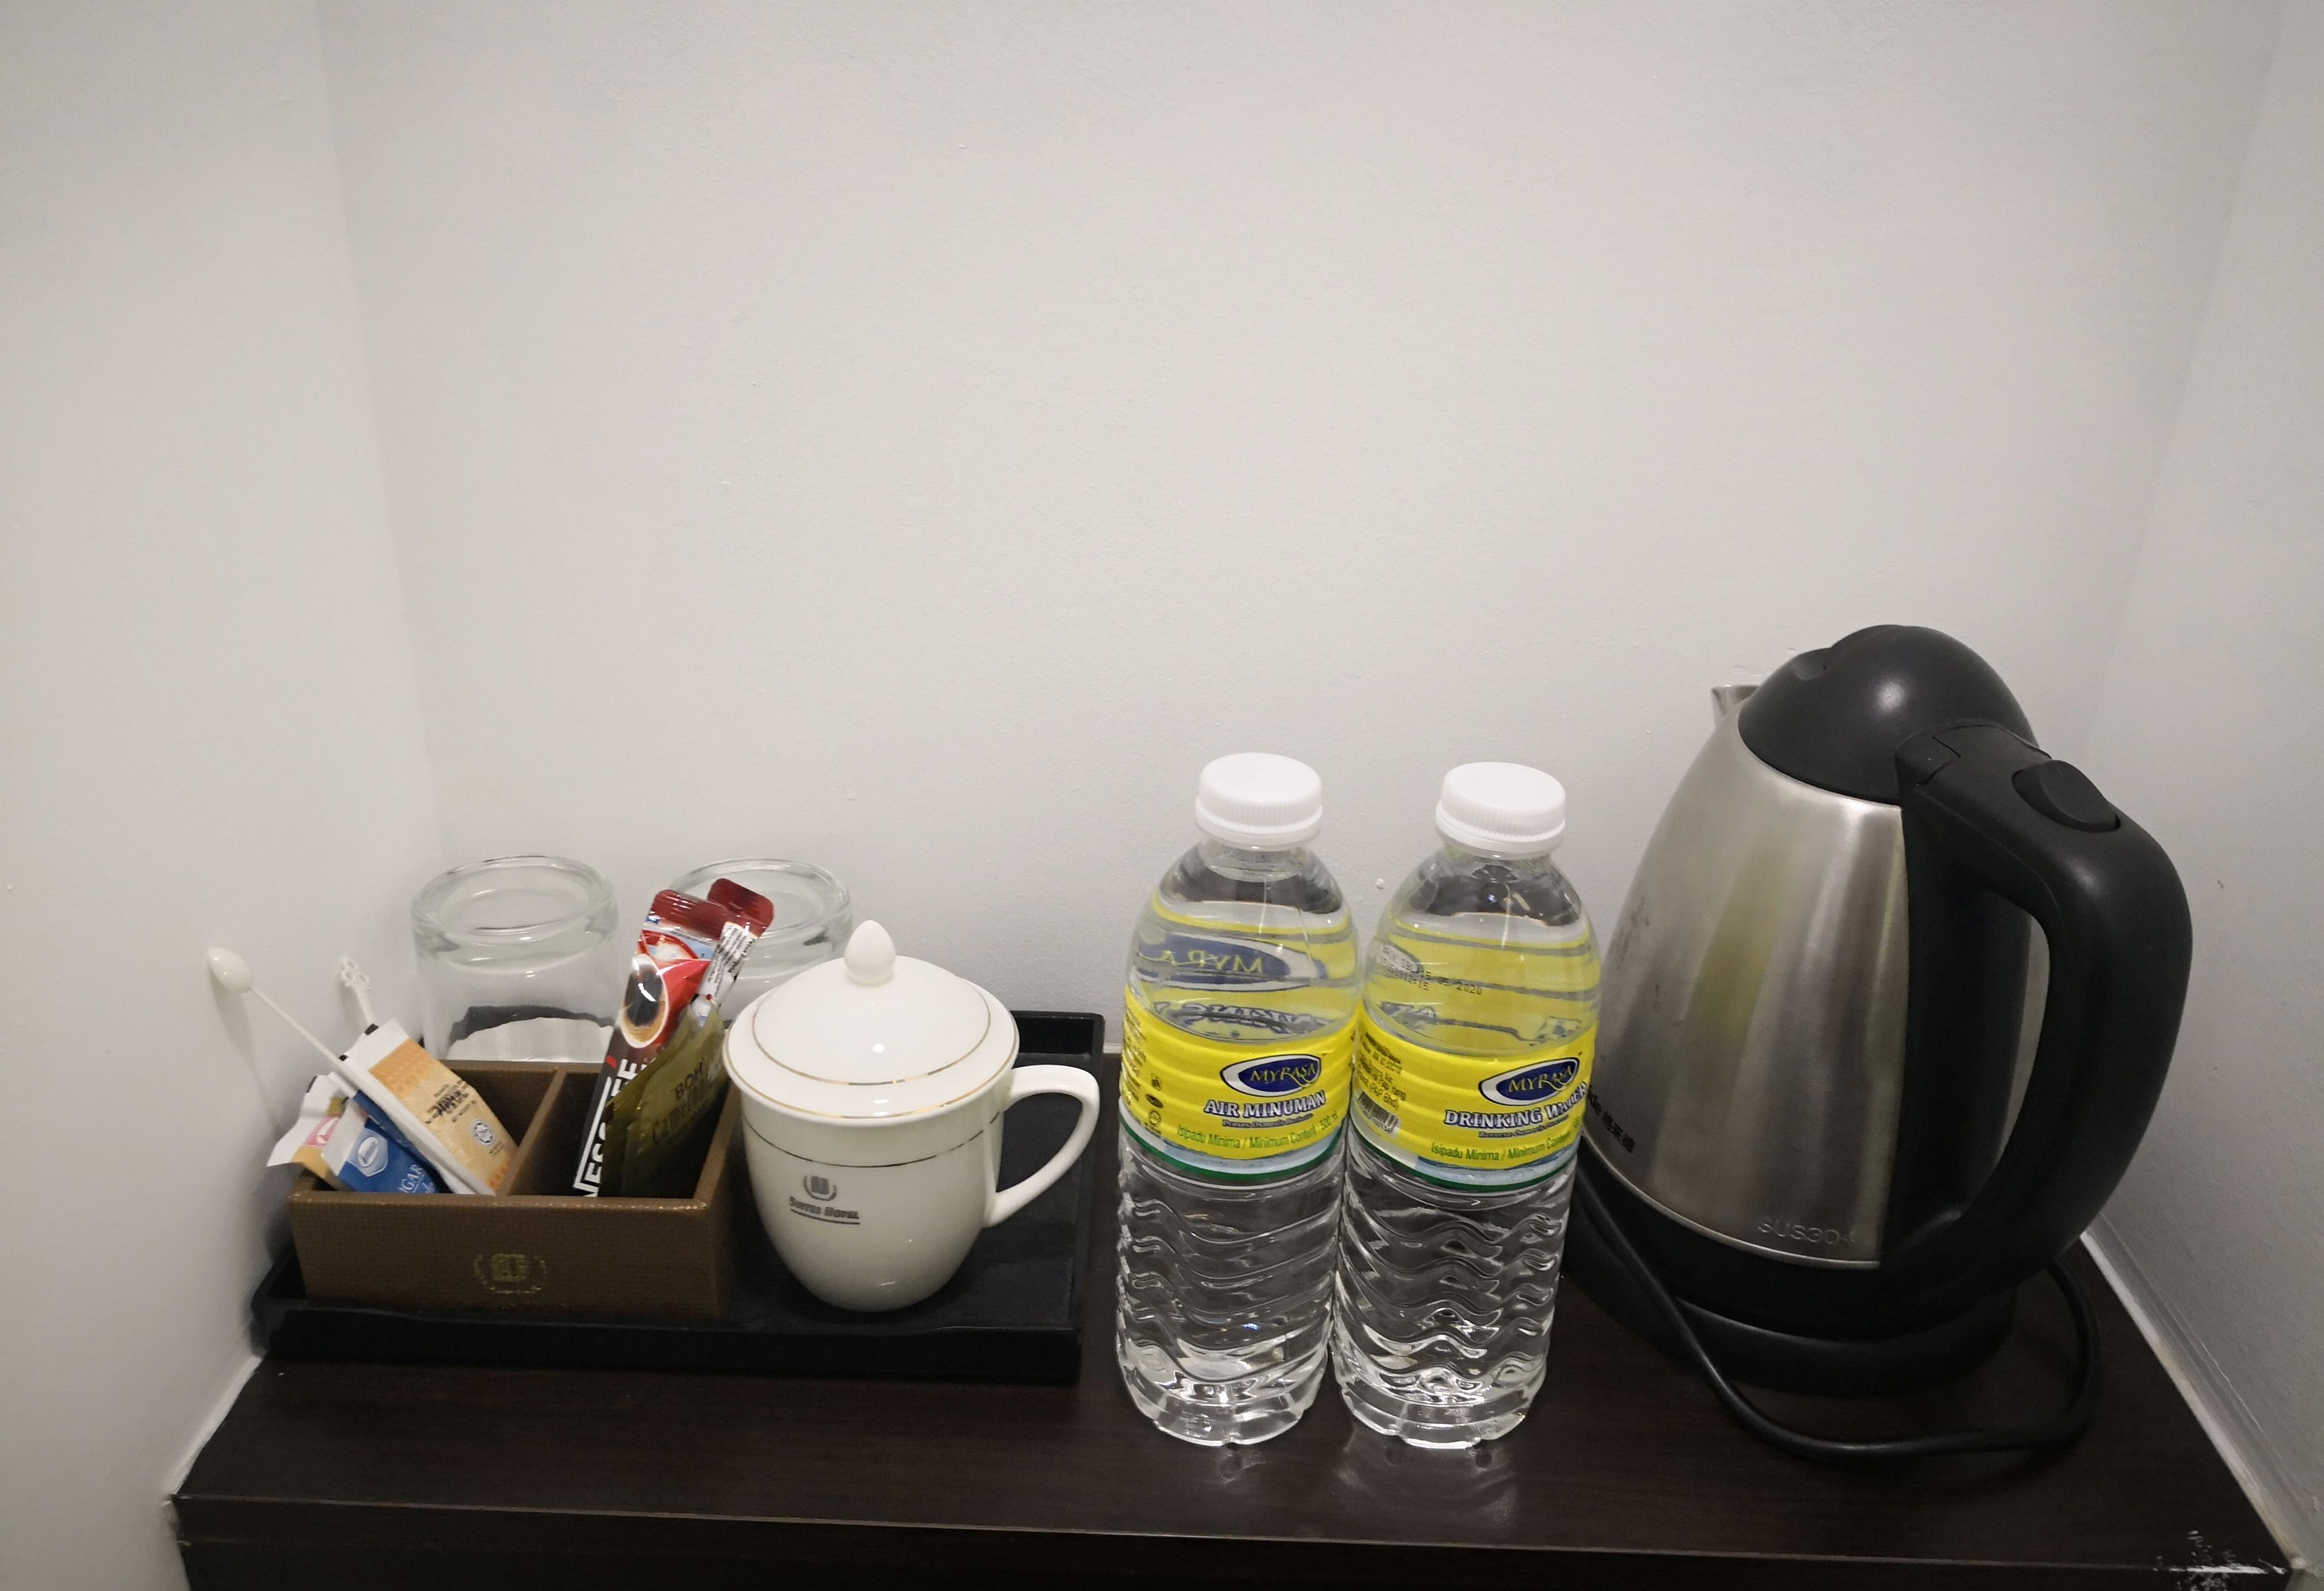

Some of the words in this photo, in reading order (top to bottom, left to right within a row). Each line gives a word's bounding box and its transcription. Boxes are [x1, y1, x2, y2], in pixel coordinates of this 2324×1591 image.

[675, 1061, 704, 1101] BOH
[1250, 1062, 1319, 1088] MYRASA
[1203, 1099, 1240, 1118] AIR
[1242, 1089, 1327, 1119] MINUMAN
[1443, 1109, 1543, 1129] DRINKING
[1177, 1124, 1206, 1144] Isipadu
[1209, 1133, 1241, 1148] Minima
[1249, 1132, 1289, 1149] Minimum
[1431, 1142, 1463, 1160] Isipadu
[1465, 1148, 1500, 1161] Minima
[1508, 1143, 1546, 1160] Minimum
[1757, 1217, 1856, 1245] SUS304
